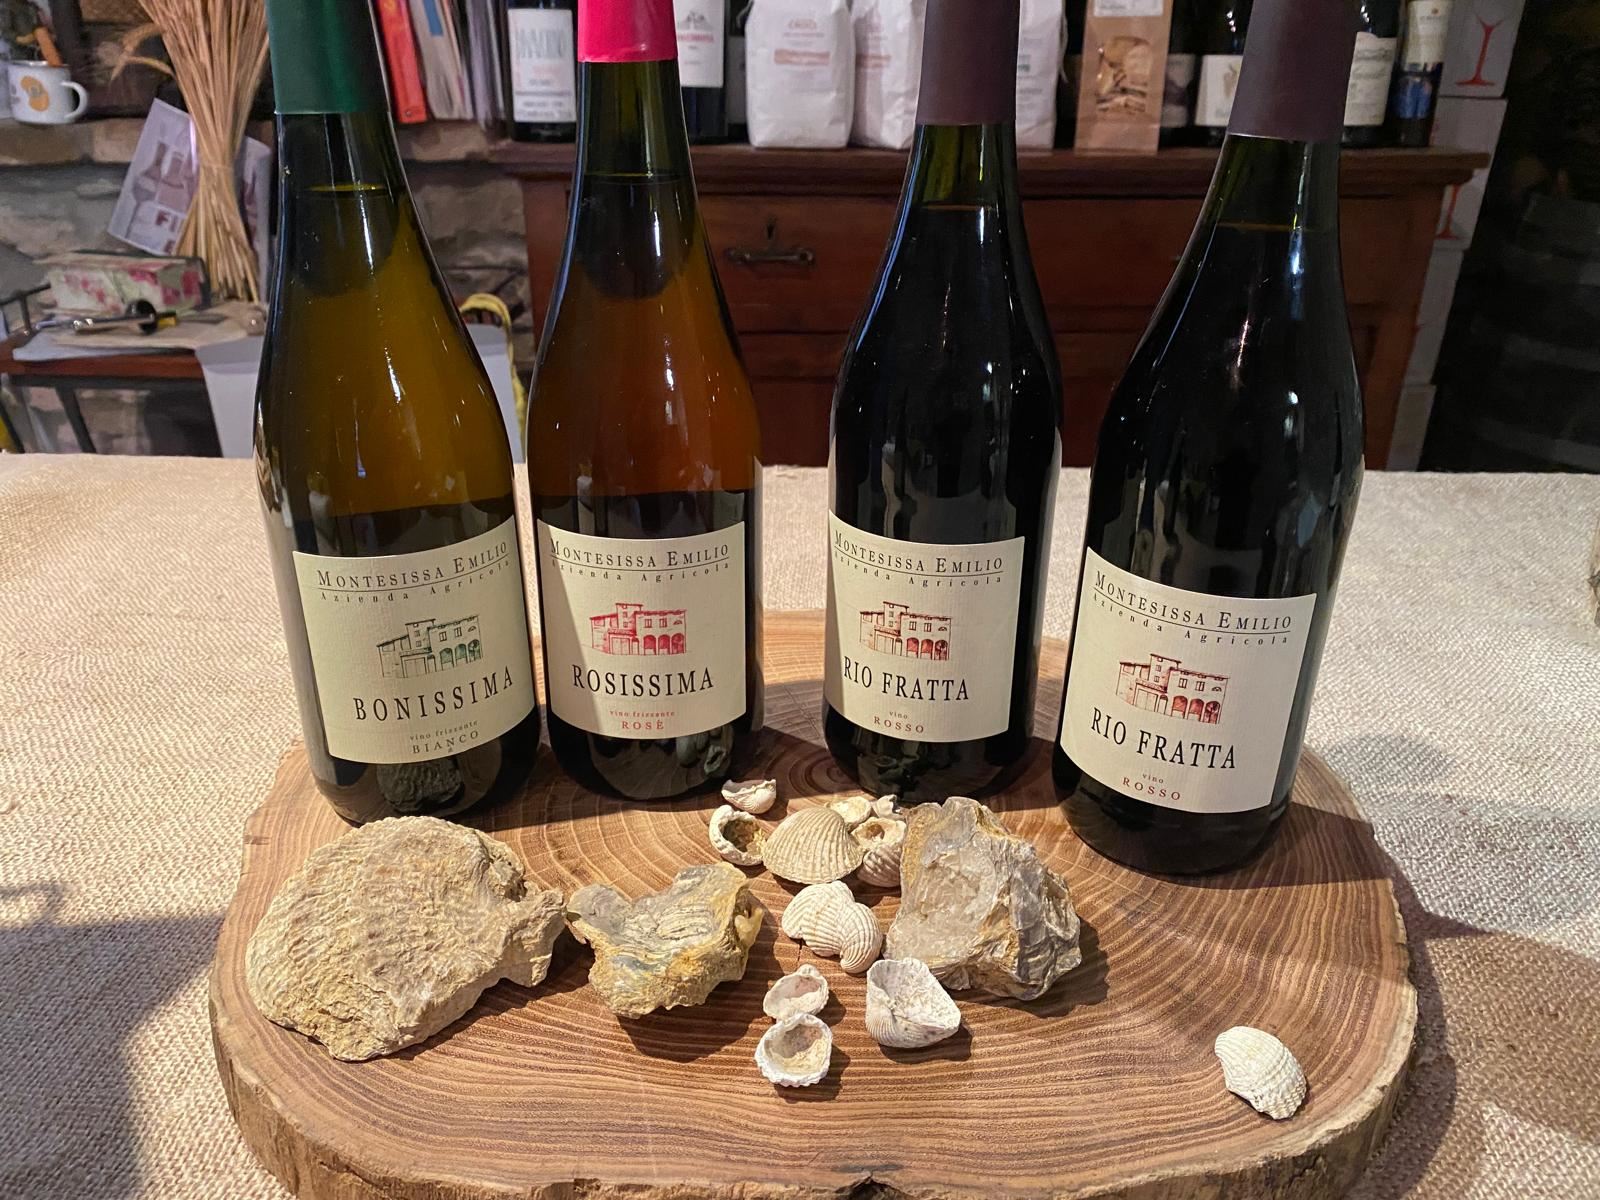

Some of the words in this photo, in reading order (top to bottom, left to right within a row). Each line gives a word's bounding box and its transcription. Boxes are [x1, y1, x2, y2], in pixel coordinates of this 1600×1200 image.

[317, 569, 444, 588] MONTESISSA
[454, 541, 507, 573] EMILIO
[551, 538, 656, 567] MONTESISSA
[667, 544, 728, 566] EMILIO
[835, 530, 924, 572] MONTESISSA
[936, 557, 1002, 573] EMILIO
[430, 561, 510, 595] Agricola
[641, 562, 729, 582] Agricola
[909, 576, 1001, 588] Agricola
[1095, 570, 1205, 626] MONTESISSA
[1218, 612, 1291, 629] EMILIO
[1185, 630, 1287, 645] Agricola
[572, 665, 714, 697] ROSISSIMA
[843, 656, 872, 688] RIO
[882, 672, 969, 701] FRATTA
[353, 665, 514, 721] BONISSIMA
[874, 716, 924, 733] ROSSO
[889, 710, 908, 720] vino
[410, 733, 431, 741] vino
[413, 730, 479, 754] BIANCO
[1091, 707, 1126, 745] RIO
[1137, 730, 1236, 769] FRATTA
[1122, 777, 1181, 800] ROSSO
[1142, 773, 1164, 784] vino
